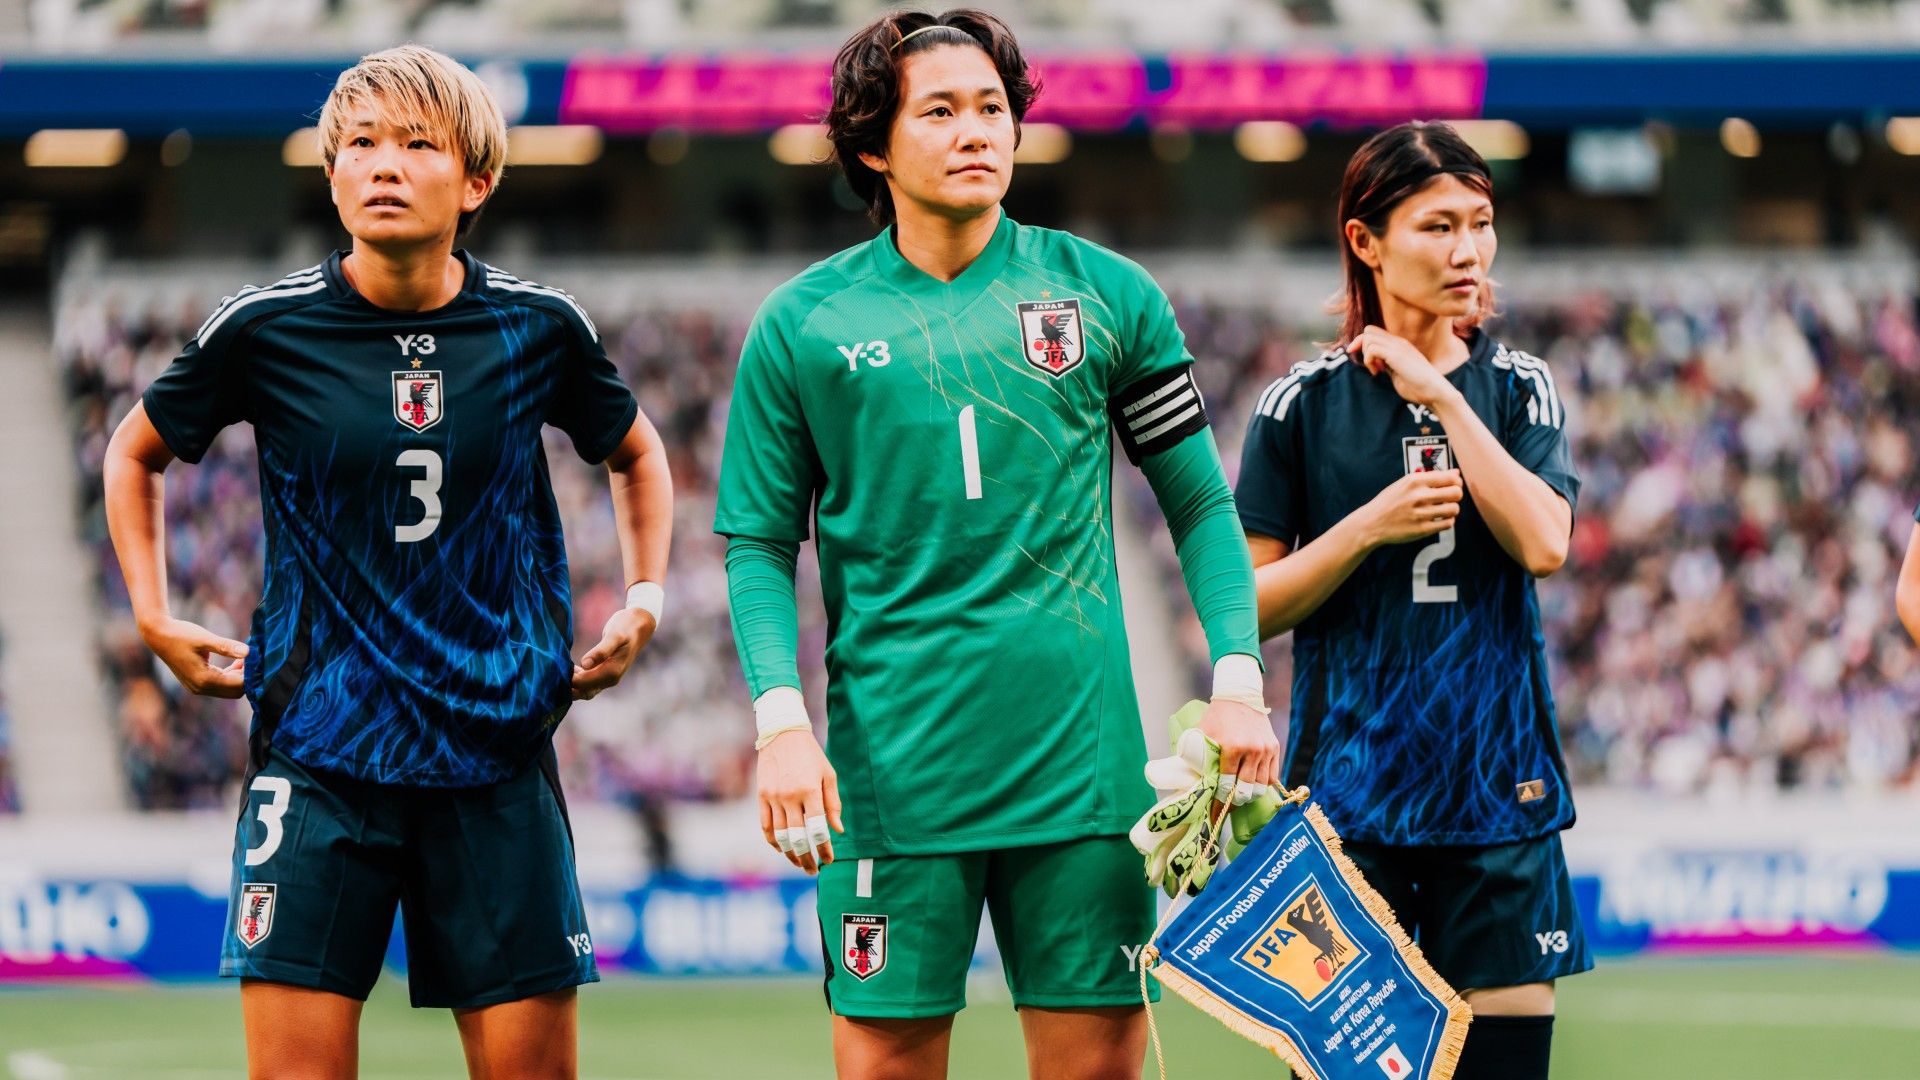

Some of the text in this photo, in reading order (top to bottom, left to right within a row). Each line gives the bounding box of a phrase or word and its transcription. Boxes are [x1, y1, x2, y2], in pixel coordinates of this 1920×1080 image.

[1032, 302, 1065, 310] JAPAN
[393, 333, 437, 356] Y-3
[836, 340, 891, 371] Y-3
[1042, 350, 1069, 363] JFA
[408, 411, 430, 420] JFA
[958, 404, 983, 500] 1
[395, 449, 443, 543] 3
[1412, 526, 1458, 603] 2
[244, 775, 292, 866] 3
[1186, 834, 1311, 960] Japan Football Association
[566, 932, 592, 958] Y-3
[1252, 927, 1298, 969] JFA
[1535, 930, 1569, 956] Y-3
[1323, 1030, 1344, 1053] Japan
[1349, 1004, 1372, 1027] Korea
[1367, 978, 1397, 1011] Republic
